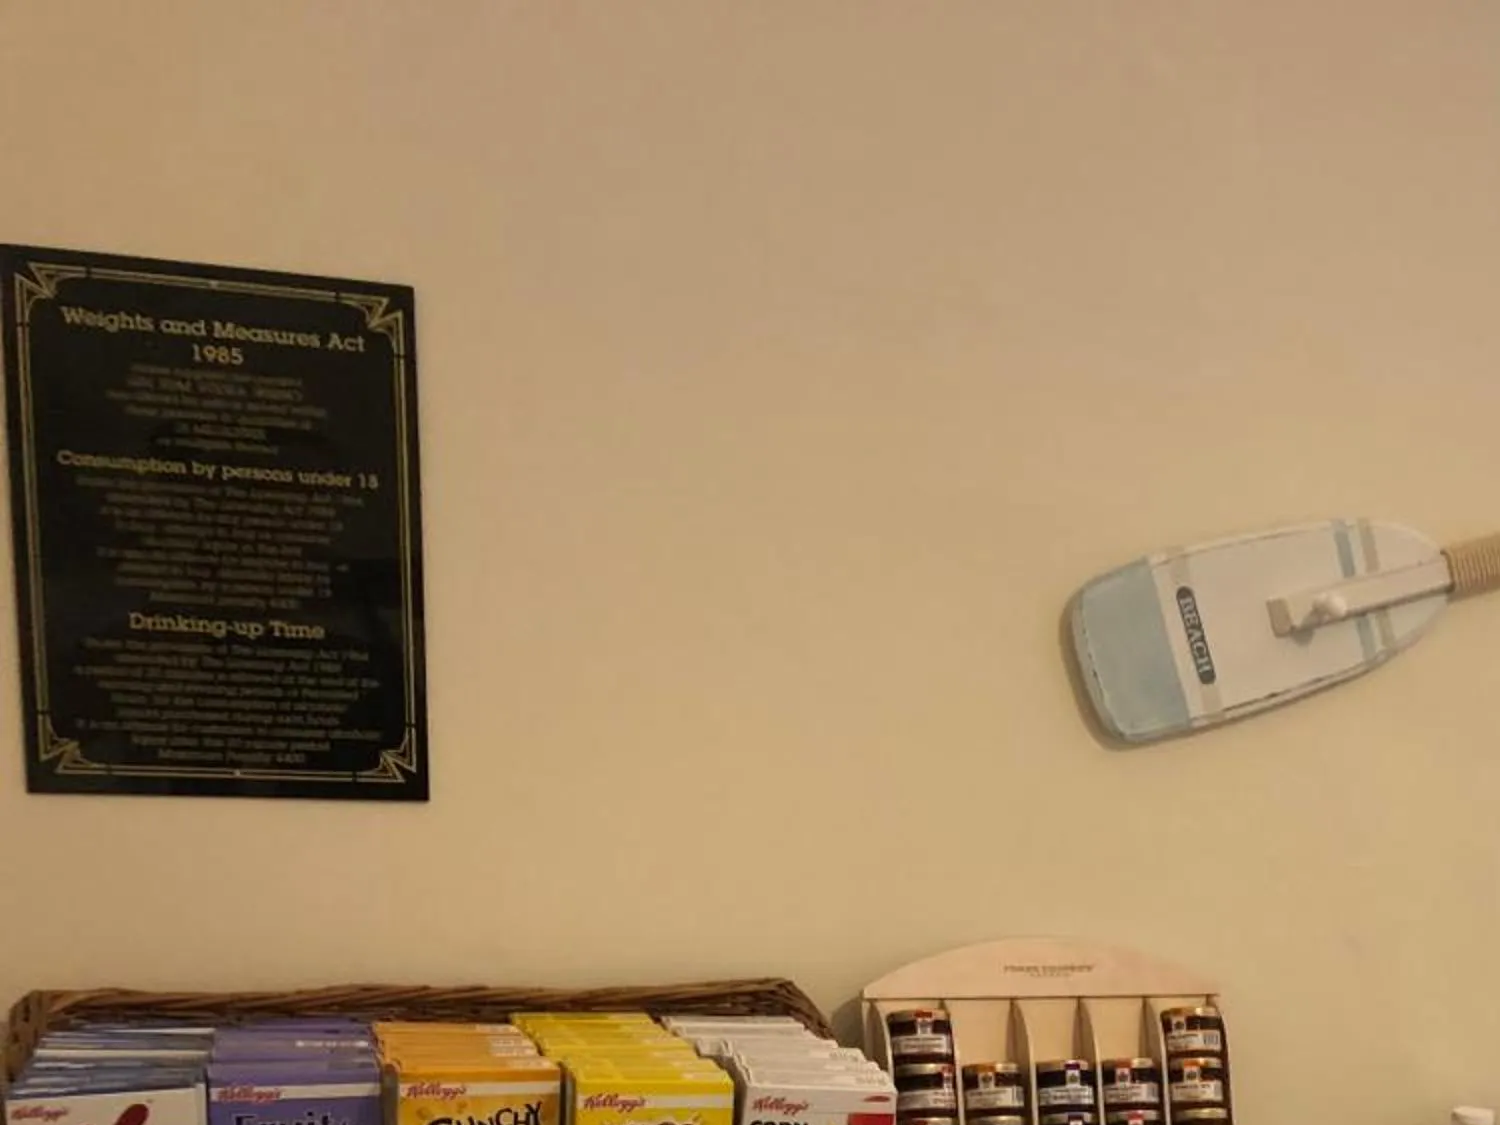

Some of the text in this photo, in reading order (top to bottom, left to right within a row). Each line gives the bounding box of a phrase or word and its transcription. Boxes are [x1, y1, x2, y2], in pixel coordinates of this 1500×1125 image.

[60, 306, 367, 353] Weights and Measures Act
[191, 344, 244, 366] 1985
[56, 449, 380, 491] Consumption by persons under 18
[128, 611, 326, 640] Drinking-up Time
[1179, 595, 1212, 674] BEACH
